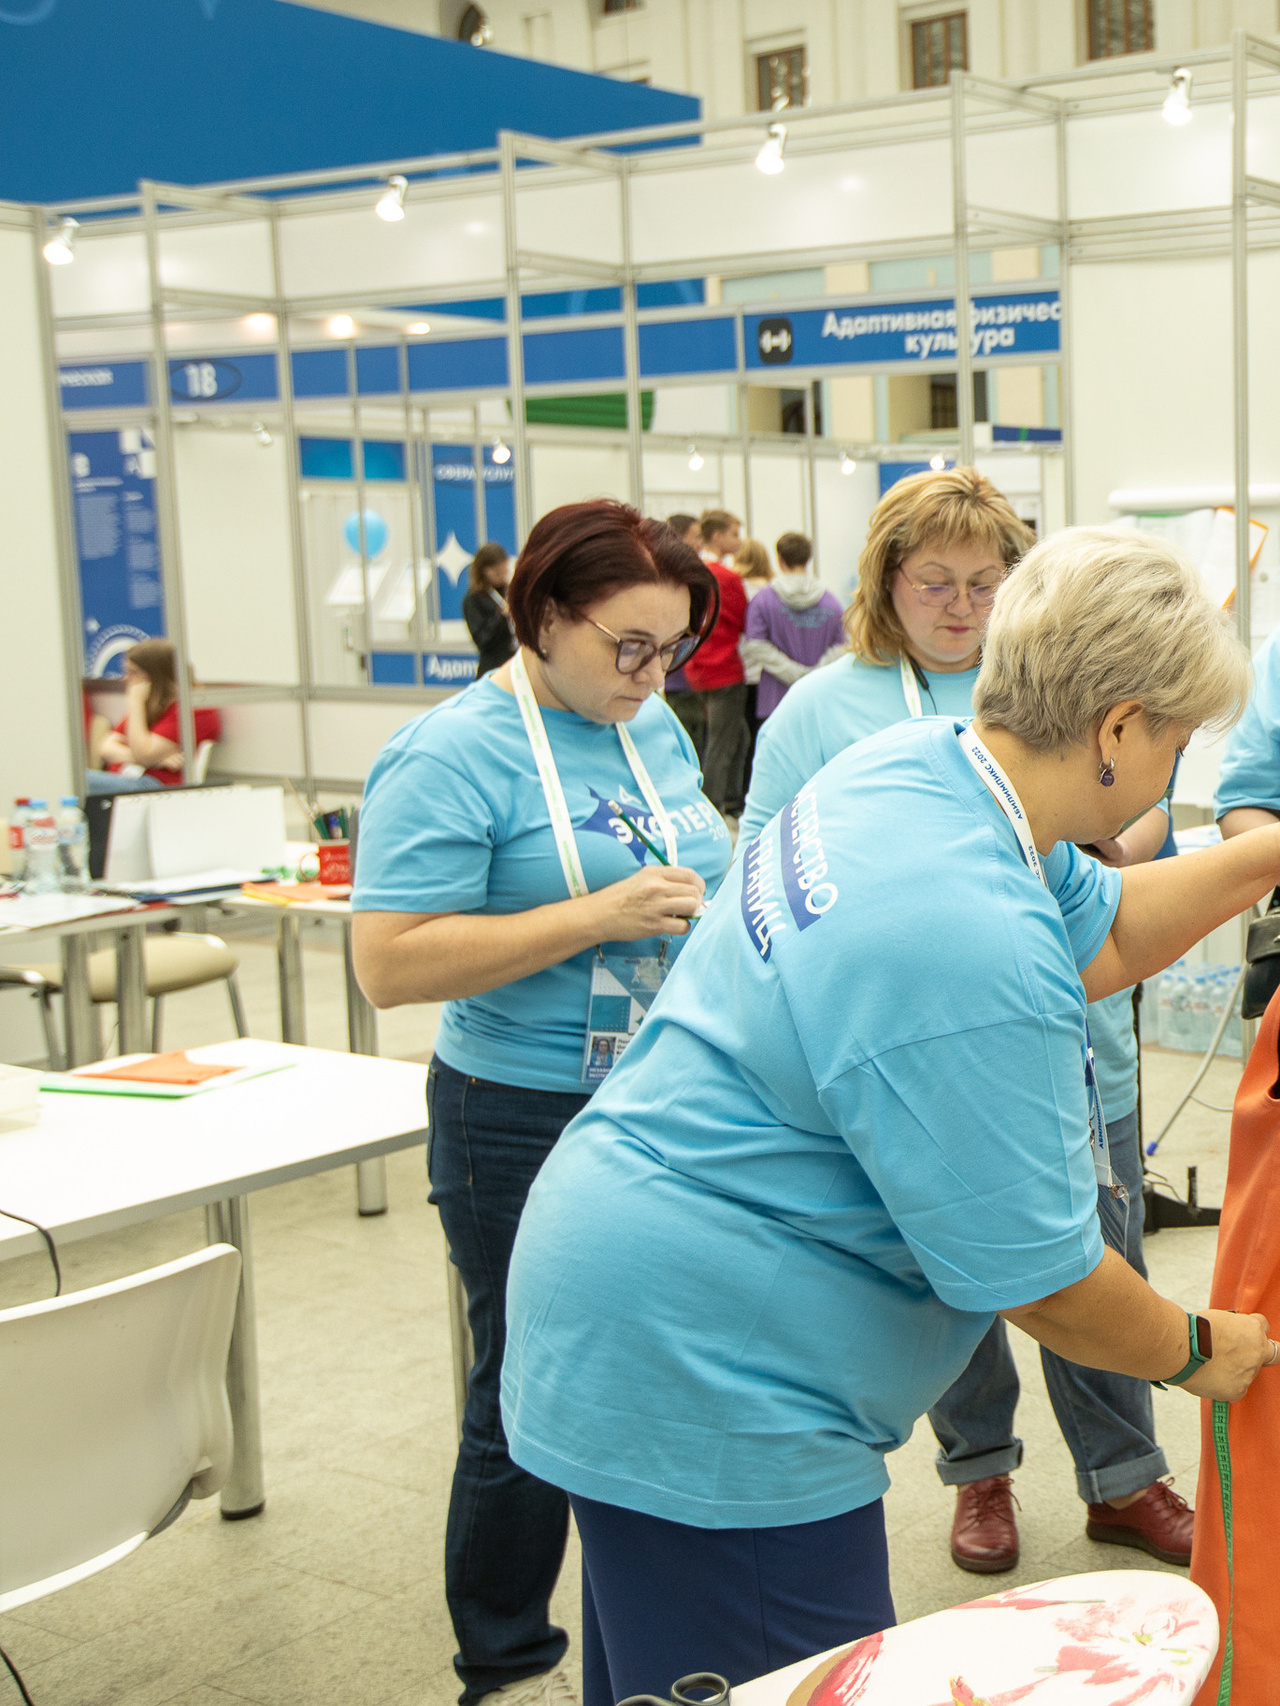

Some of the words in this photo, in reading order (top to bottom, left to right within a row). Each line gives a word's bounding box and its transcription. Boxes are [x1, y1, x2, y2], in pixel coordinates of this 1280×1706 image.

[822, 311, 957, 340] Адаптивная
[904, 327, 1015, 360] кульура
[185, 363, 218, 398] 18
[971, 746, 988, 764] 2022
[984, 763, 1023, 820] АБИЛИМПИКС
